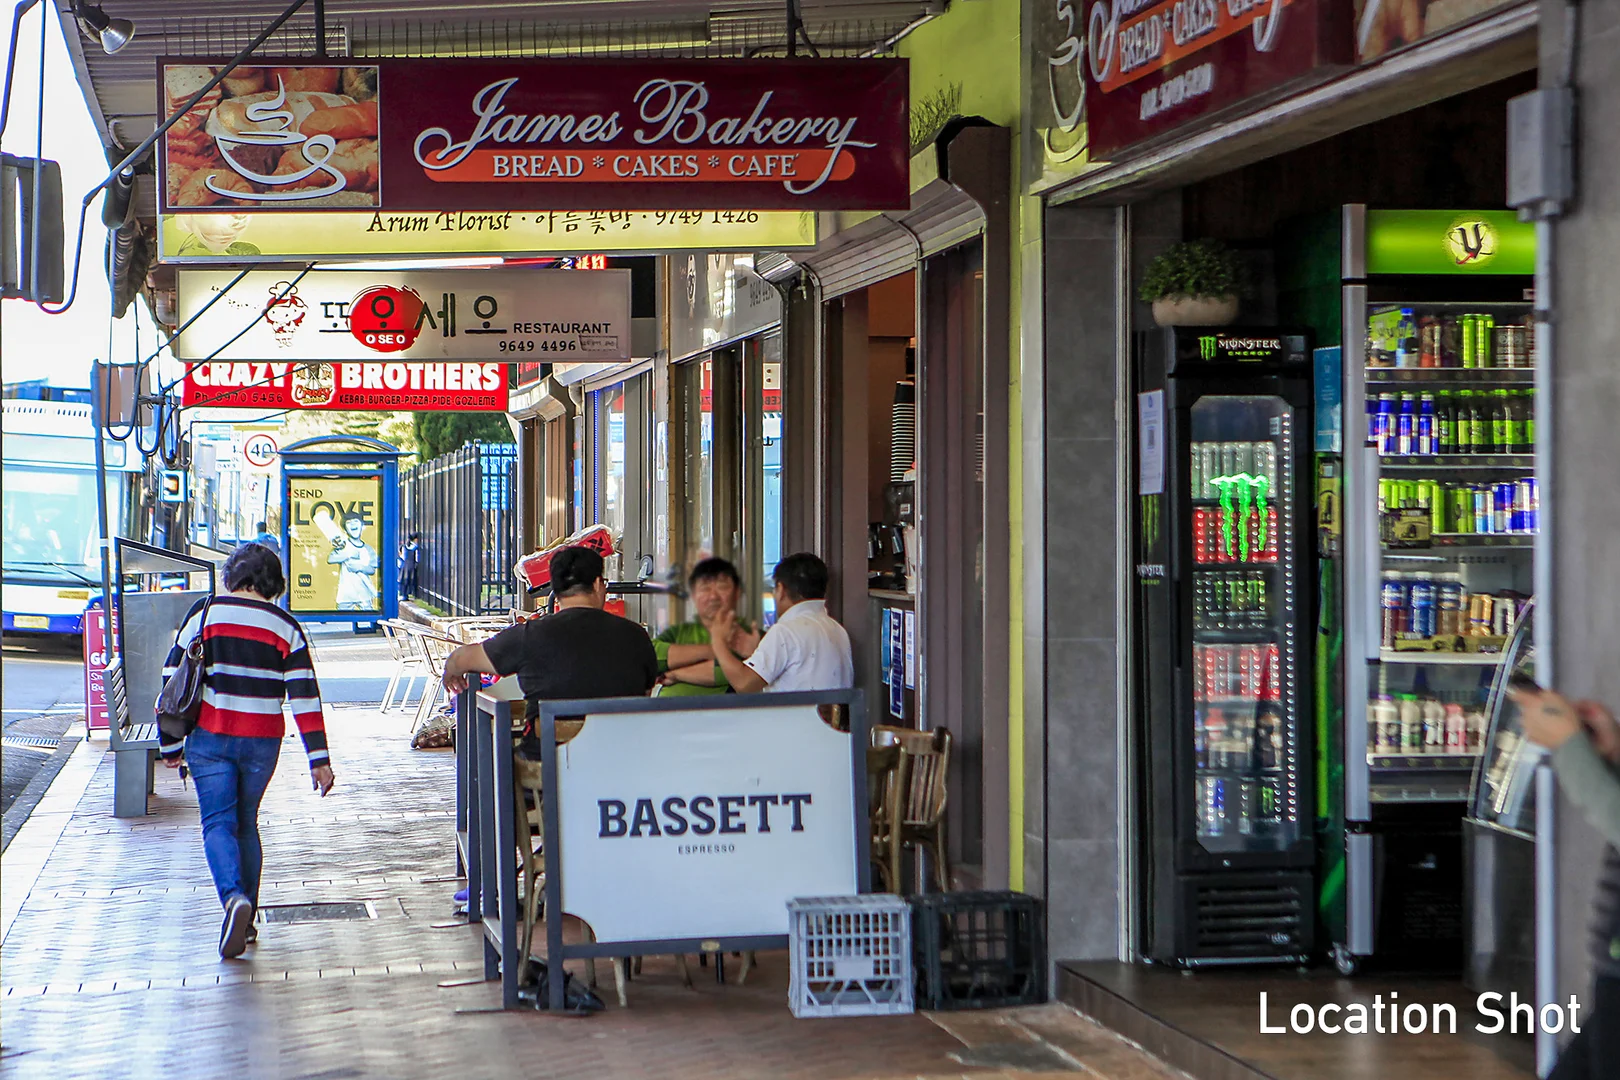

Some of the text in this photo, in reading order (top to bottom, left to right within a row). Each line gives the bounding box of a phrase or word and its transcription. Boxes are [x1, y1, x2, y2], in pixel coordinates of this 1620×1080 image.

[1119, 15, 1164, 73] BREAD
[414, 77, 877, 195] James Bakery
[493, 155, 584, 177] BREAD
[613, 155, 699, 177] CAKES
[366, 211, 429, 232] Arum
[435, 211, 512, 232] Florist
[655, 210, 702, 225] 9749
[712, 210, 758, 224] 1426
[513, 323, 611, 334] RESTAURANT
[499, 341, 535, 352] 9649
[541, 341, 576, 352] 4496
[1218, 338, 1281, 350] MONSTER
[192, 362, 288, 388] CRAZY
[341, 363, 500, 391] BROTHERS
[252, 392, 283, 403] 5456
[293, 489, 323, 499] SEND
[294, 501, 373, 526] LOVE
[597, 793, 812, 838] BASSETT
[678, 844, 735, 855] ESPRESSO
